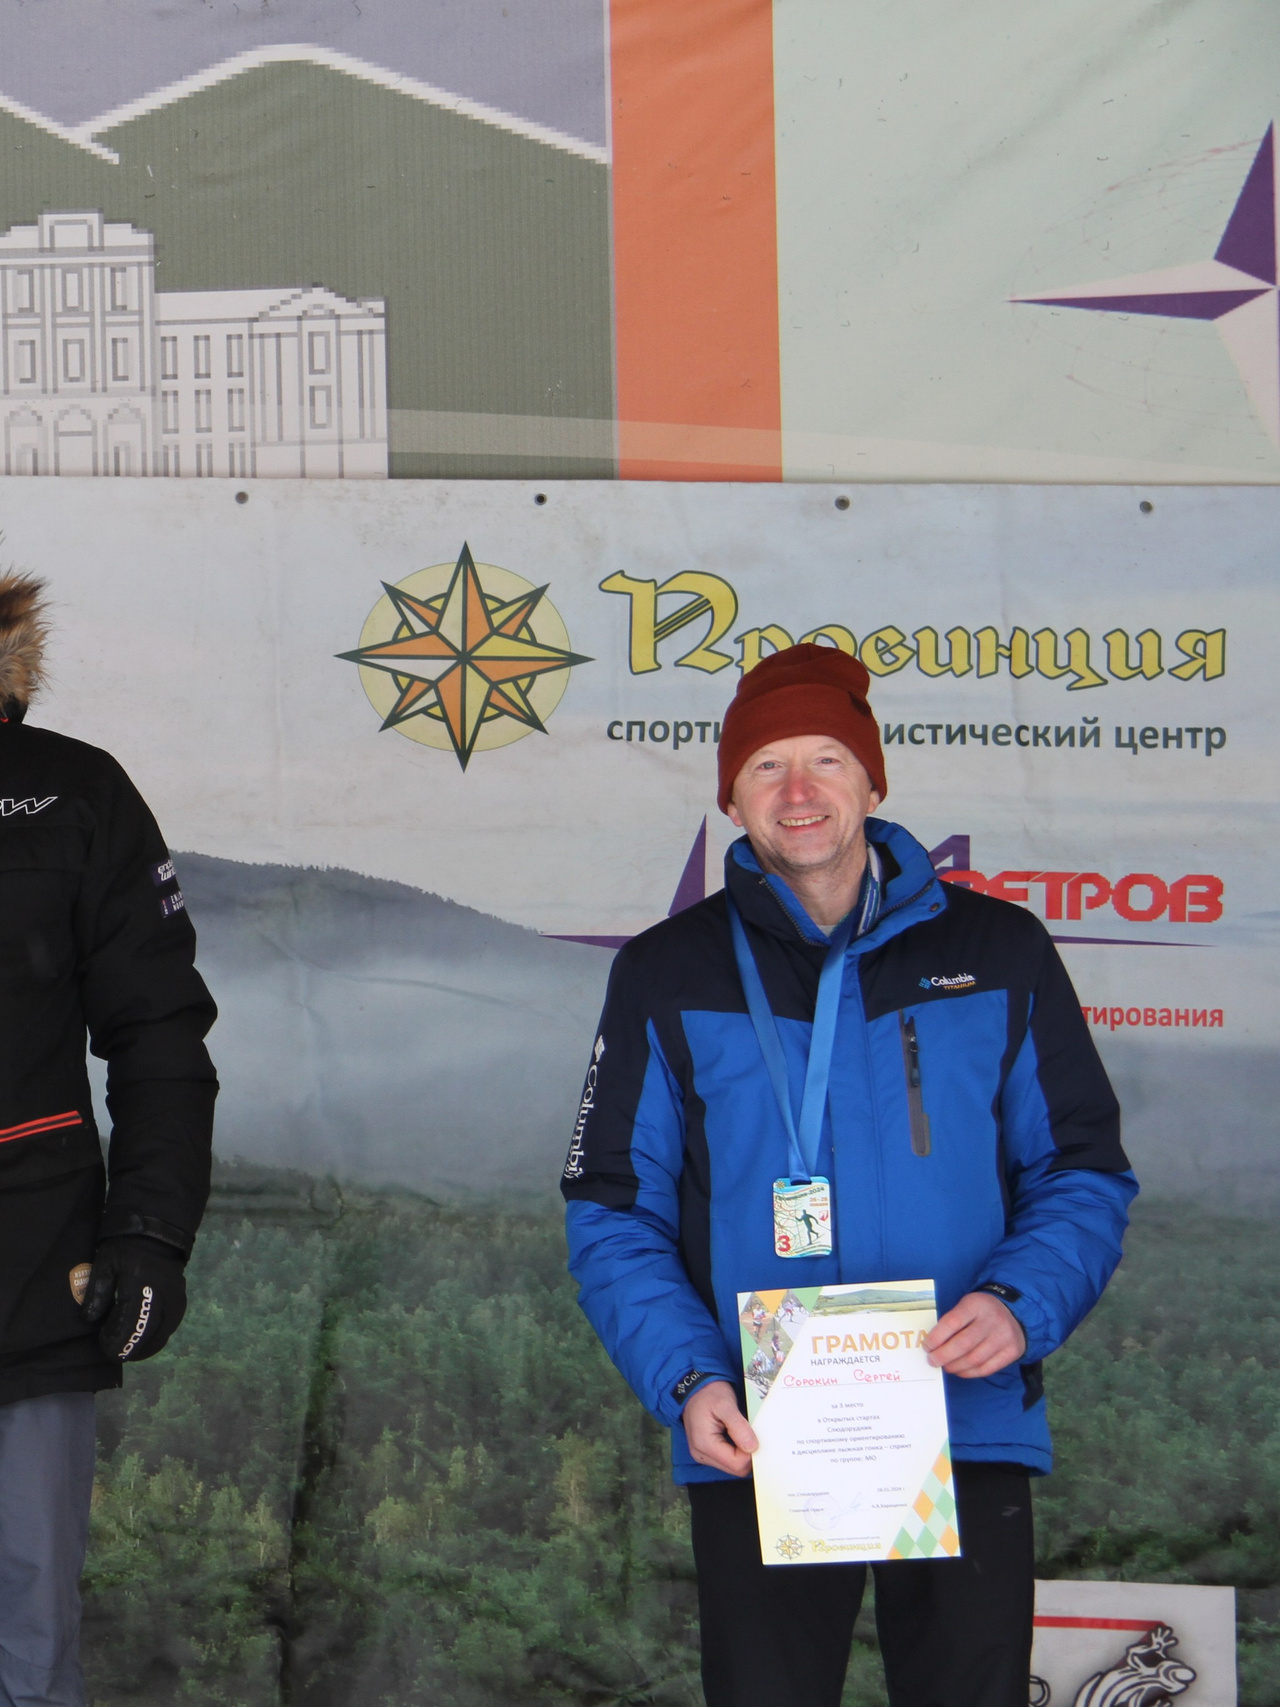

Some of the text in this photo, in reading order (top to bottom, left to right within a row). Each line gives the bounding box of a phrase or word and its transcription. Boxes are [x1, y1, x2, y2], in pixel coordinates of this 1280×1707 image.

[1114, 716, 1227, 756] центр
[931, 973, 975, 986] Columbia
[943, 981, 976, 990] TITANIUM
[1081, 1006, 1223, 1031] тирования
[777, 1235, 791, 1252] 3
[811, 1355, 881, 1367] НАГРАЖДАЕТСЯ
[783, 1369, 901, 1388] Сорокин Сергей
